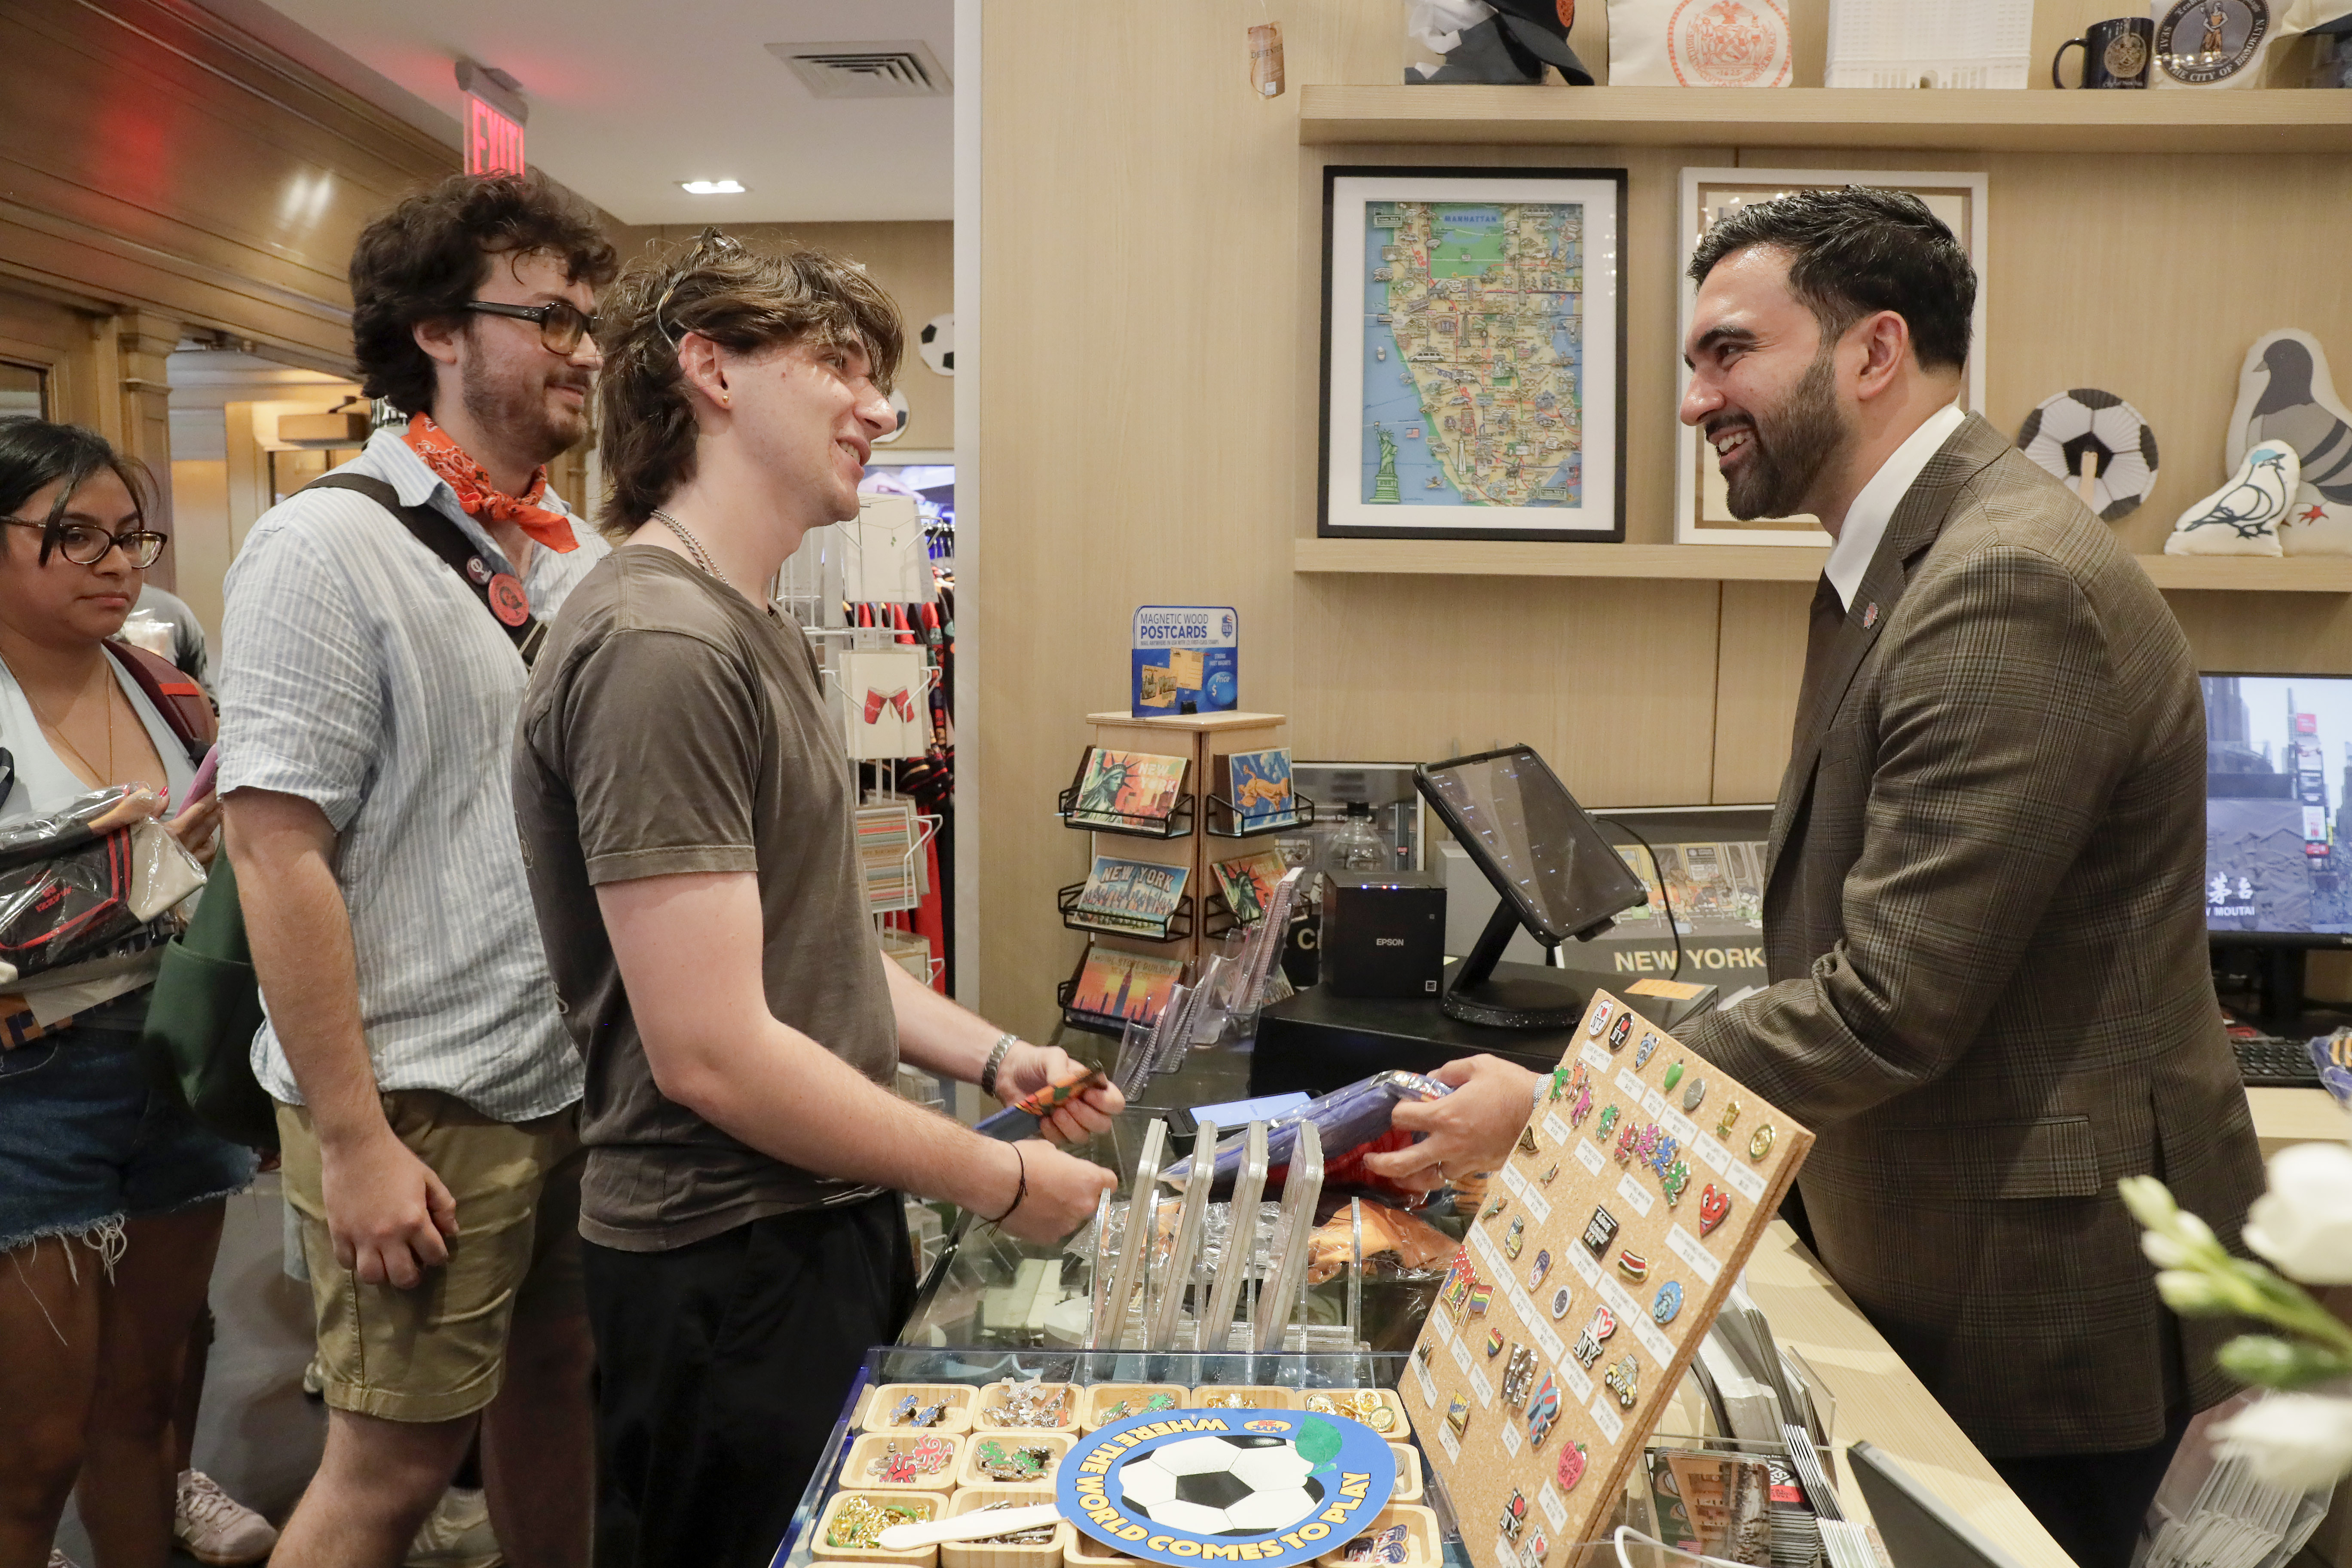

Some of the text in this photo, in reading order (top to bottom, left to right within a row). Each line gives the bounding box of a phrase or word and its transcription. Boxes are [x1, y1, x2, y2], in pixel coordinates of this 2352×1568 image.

[2160, 26, 2172, 49] SEAL
[2190, 72, 2214, 81] CITY
[2219, 64, 2233, 76] OF
[2235, 19, 2266, 66] BROOKLYN
[473, 98, 519, 175] EXIT
[1444, 214, 1498, 223] MANHATTAN
[1141, 613, 1209, 624] MAGNETIC WOOD
[1141, 625, 1207, 639] POSTCARDS
[1216, 674, 1230, 683] Price
[1212, 684, 1217, 697] $
[1139, 763, 1170, 777] NEW
[1101, 866, 1176, 893] NEW YORK
[2215, 906, 2255, 916] MOUTAI
[1614, 947, 1767, 972] NEW YORK
[1591, 1016, 1604, 1030] NY
[1610, 1027, 1625, 1045] NY
[1574, 1328, 1604, 1368] NY
[1075, 1418, 1371, 1561] WHERE THE WORLD COMES TO PLAY
